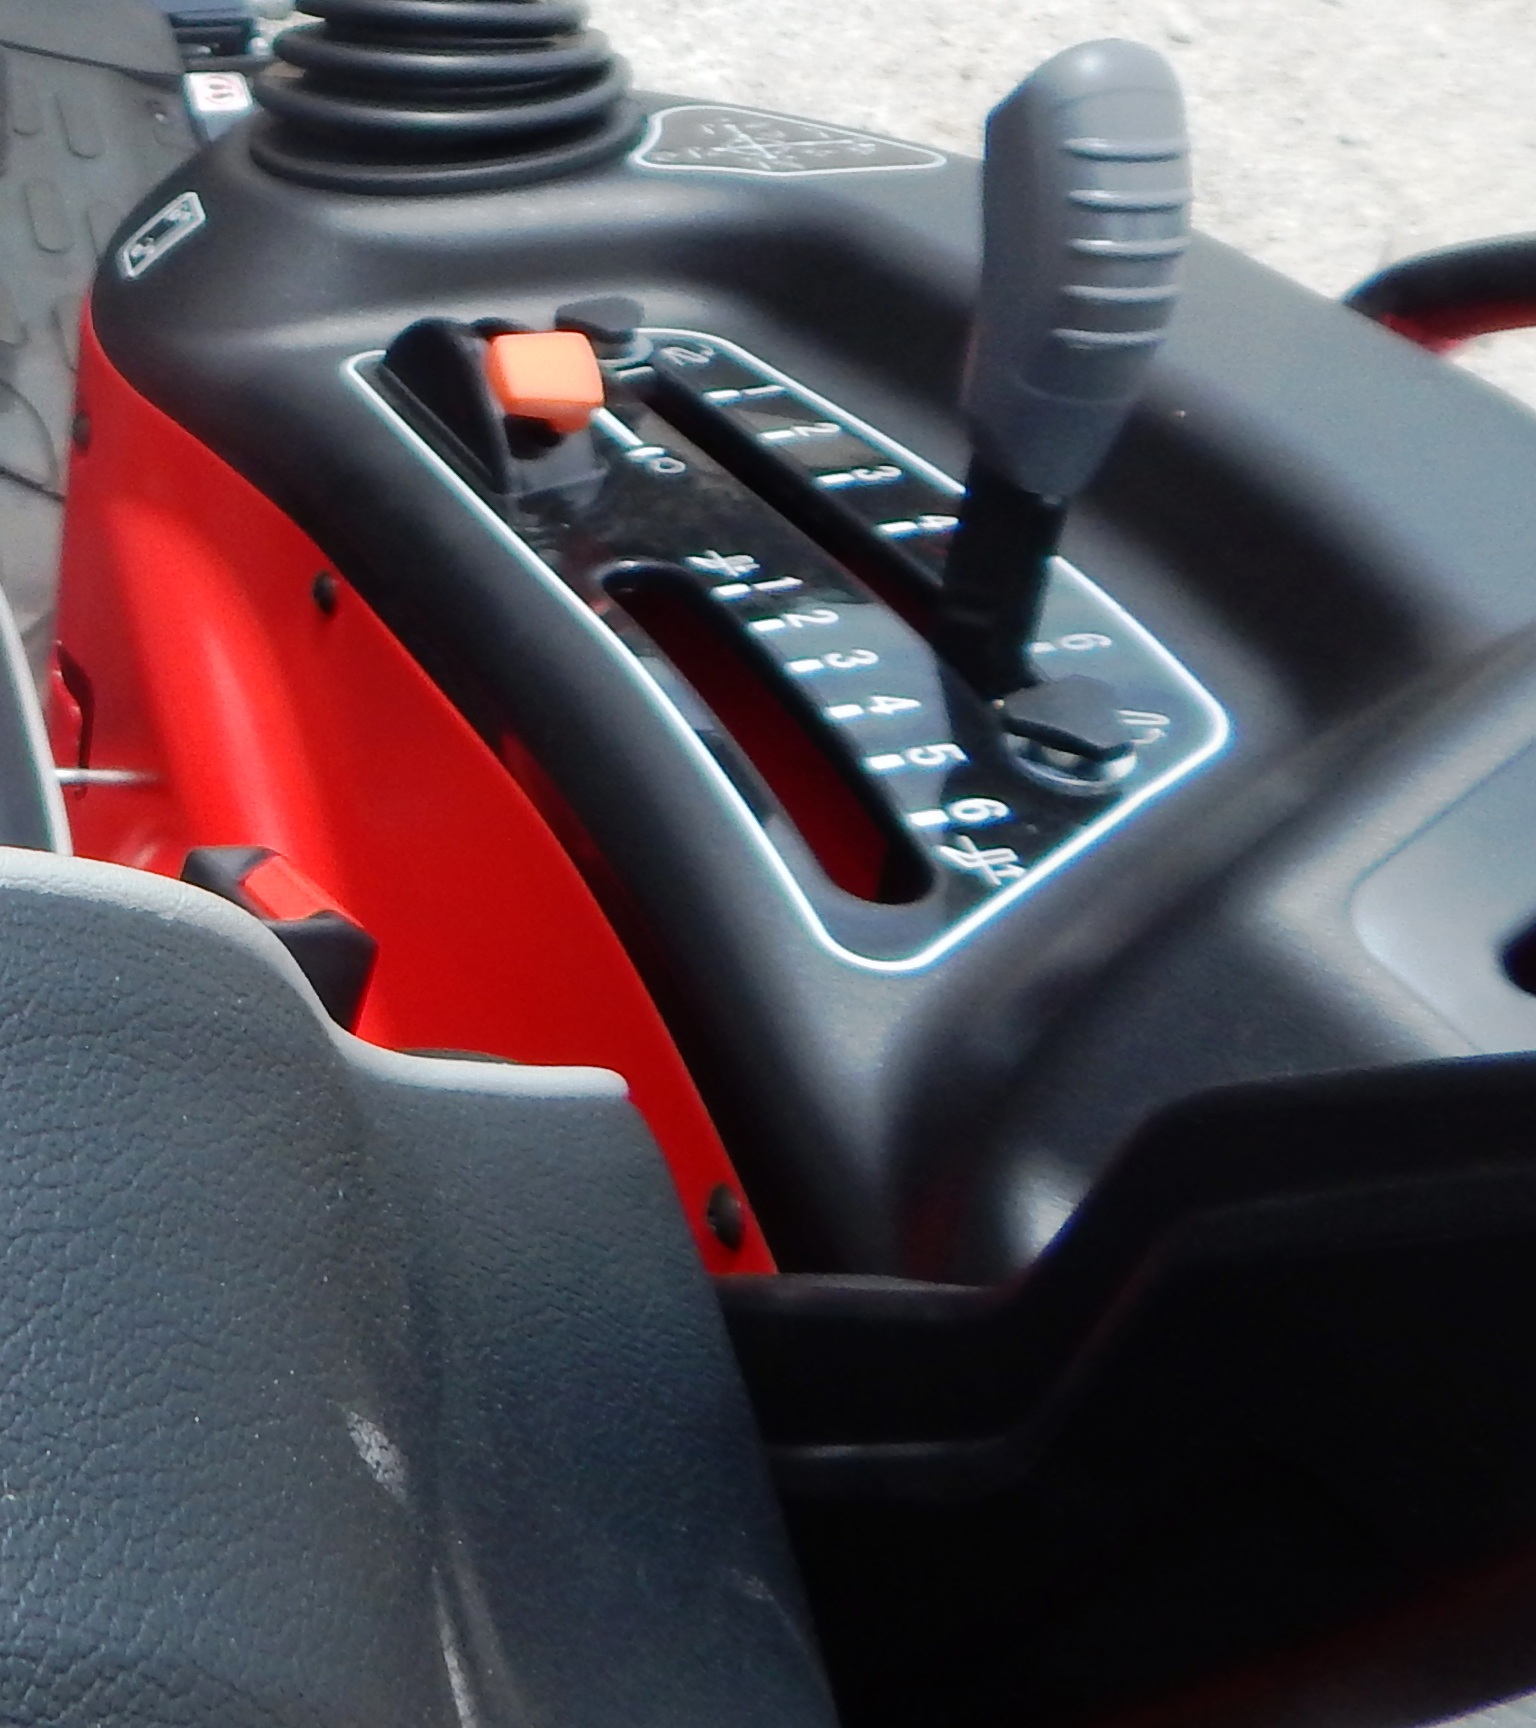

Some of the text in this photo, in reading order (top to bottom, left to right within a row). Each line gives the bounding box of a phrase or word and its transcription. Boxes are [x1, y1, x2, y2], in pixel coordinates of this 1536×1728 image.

[793, 422, 841, 437] 2
[852, 465, 903, 482] 3
[753, 576, 803, 592] 1
[782, 609, 840, 628] 2
[1059, 633, 1113, 652] 6
[823, 648, 879, 669] 3
[868, 694, 922, 715] 4
[906, 743, 969, 766] 5
[947, 797, 1011, 822] 6
